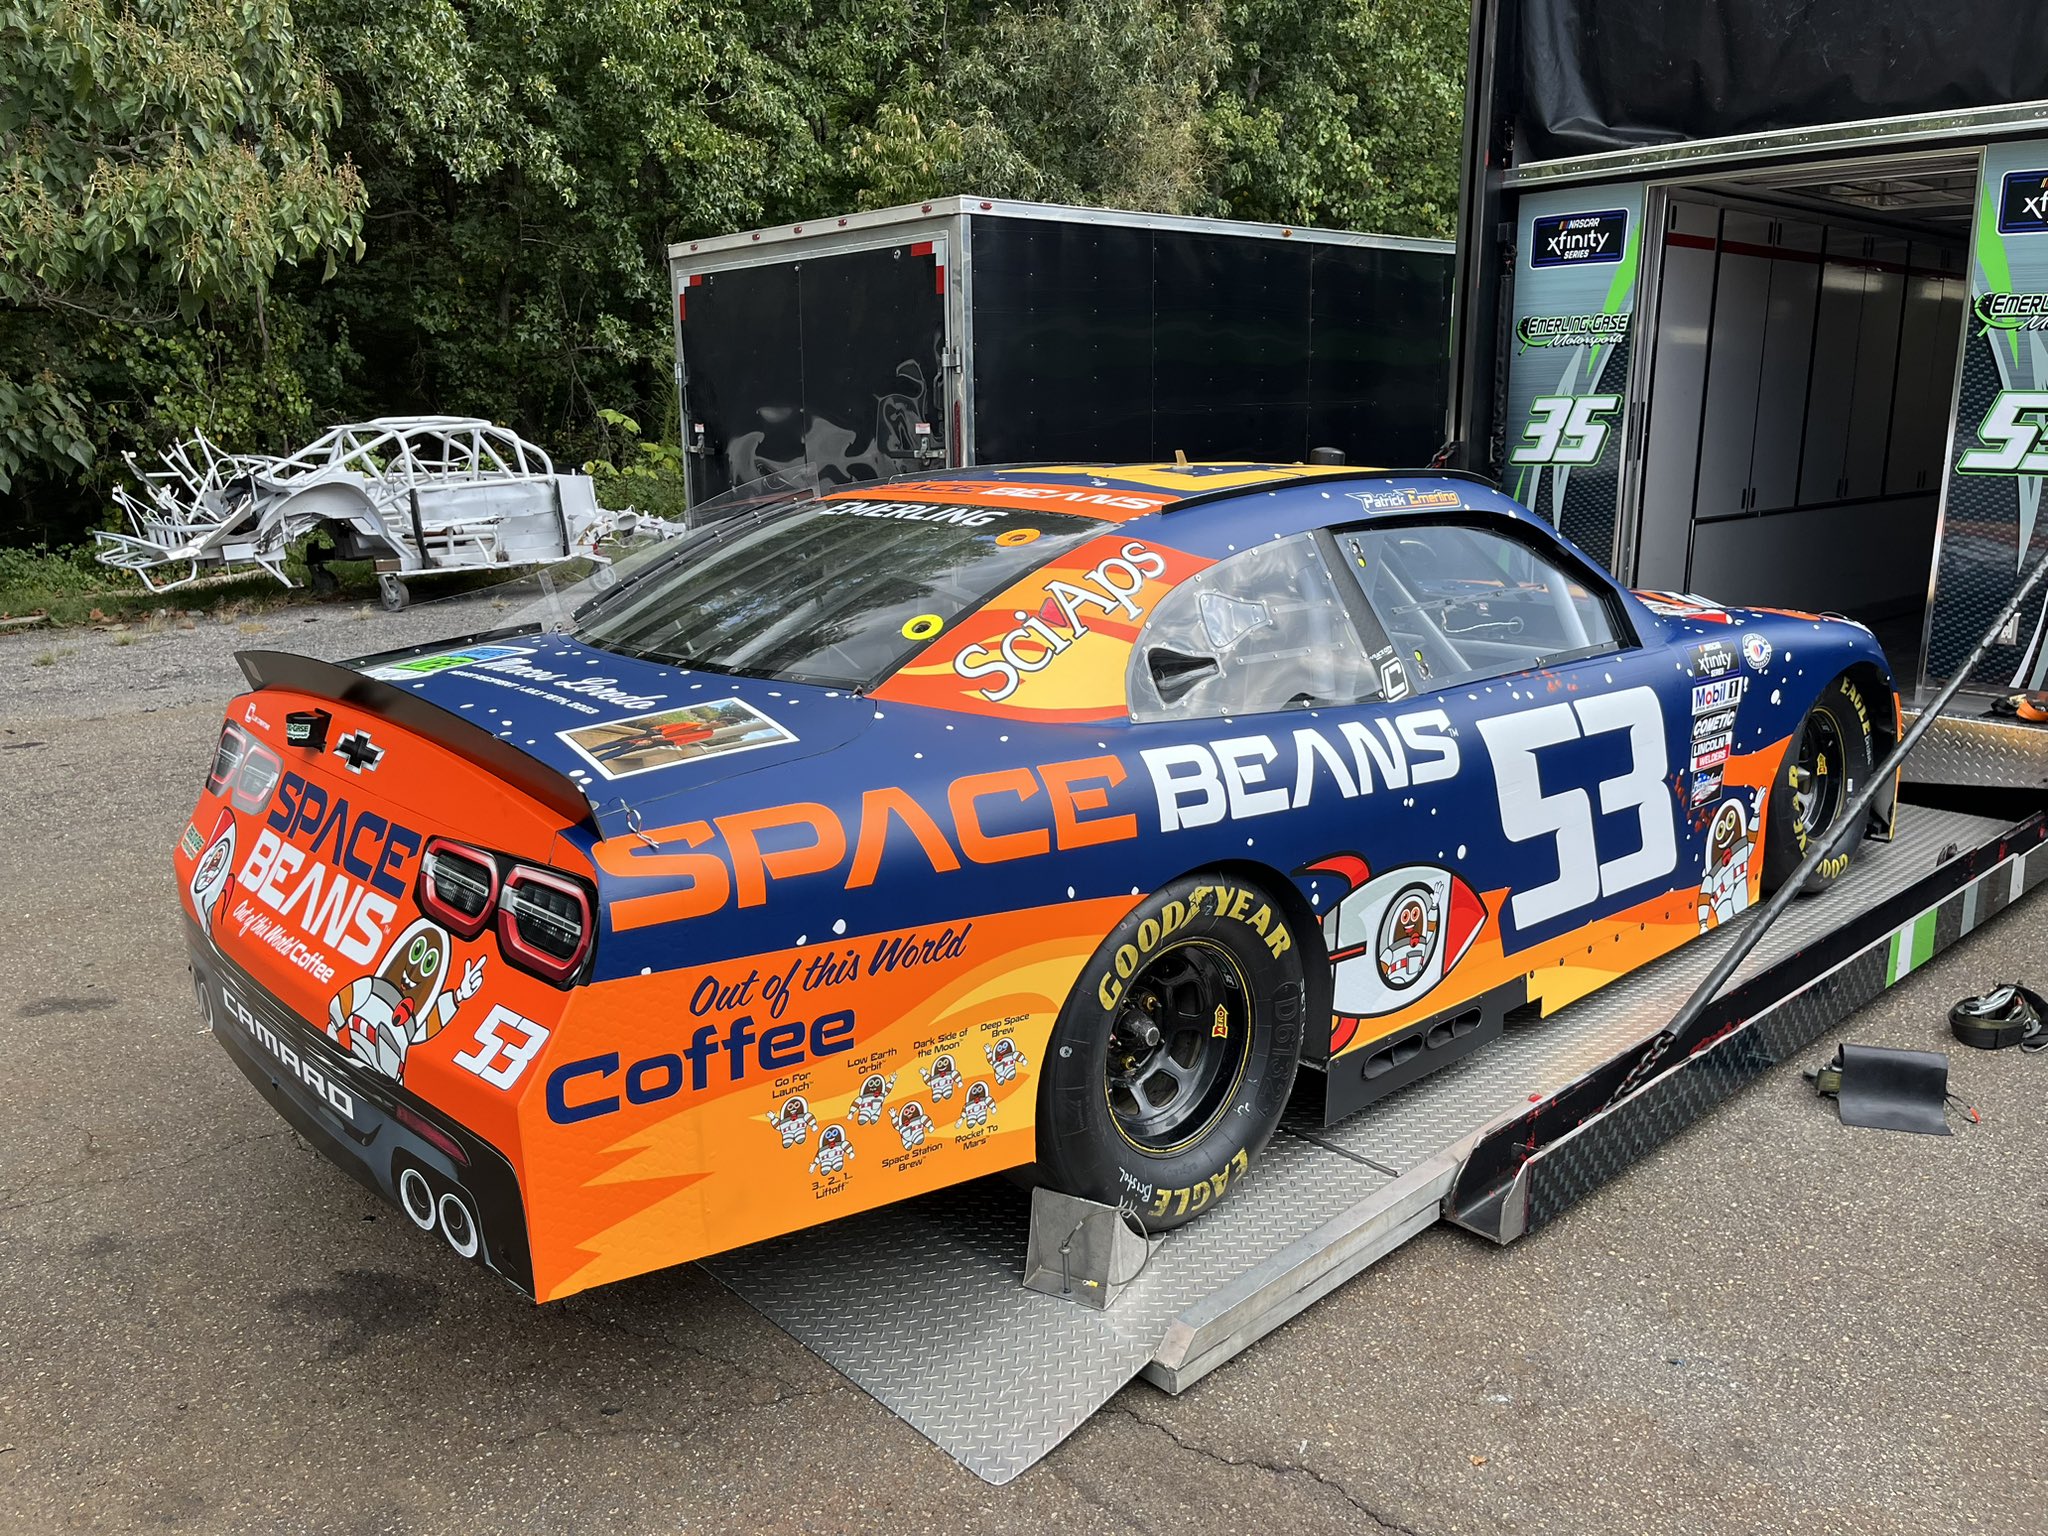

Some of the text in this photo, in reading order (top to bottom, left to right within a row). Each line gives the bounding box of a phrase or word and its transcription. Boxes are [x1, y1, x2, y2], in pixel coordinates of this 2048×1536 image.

[1568, 217, 1600, 230] NASCAR
[1547, 230, 1610, 255] xfinity
[1563, 249, 1590, 260] SERIES
[1547, 333, 1624, 348] Motorsports
[1510, 394, 1623, 466] 35
[980, 487, 1165, 509] BEANS
[1355, 490, 1459, 509] Patrick Emerling
[819, 501, 1010, 527] EMERLING
[953, 541, 1167, 702] SciAps
[1697, 650, 1732, 675] xfinity
[1696, 682, 1727, 708] Mobil
[1840, 676, 1872, 736] EAGLE
[1694, 709, 1736, 737] COMETIC
[1693, 735, 1726, 757] LINCOLN
[1698, 749, 1727, 766] WELDERS
[1140, 708, 1461, 834] BEANS
[1475, 685, 1677, 932] 53
[267, 770, 422, 898] SPACE
[592, 753, 1138, 933] SPACE
[238, 828, 398, 966] BEANS
[233, 899, 335, 984] Out of this World Coffee
[1099, 885, 1291, 1011] GOODYEAR
[689, 922, 973, 1020] Out of this World
[980, 1013, 1030, 1033] Deep Space
[991, 1025, 1015, 1038] Brew
[451, 1003, 551, 1092] 53
[913, 1027, 969, 1050] Dark Side of
[917, 1041, 960, 1058] the Moon
[222, 986, 354, 1120] CAMARO
[847, 1047, 898, 1069] Low Earth
[545, 1008, 857, 1125] Coffee
[857, 1061, 883, 1075] Orbit
[772, 1081, 811, 1099] Launch
[774, 1072, 812, 1088] Go For
[955, 1125, 998, 1145] Rocket To
[962, 1138, 987, 1151] Mars
[881, 1142, 943, 1168] Space Station
[898, 1159, 924, 1172] Brew
[1148, 1147, 1249, 1217] EAGLE
